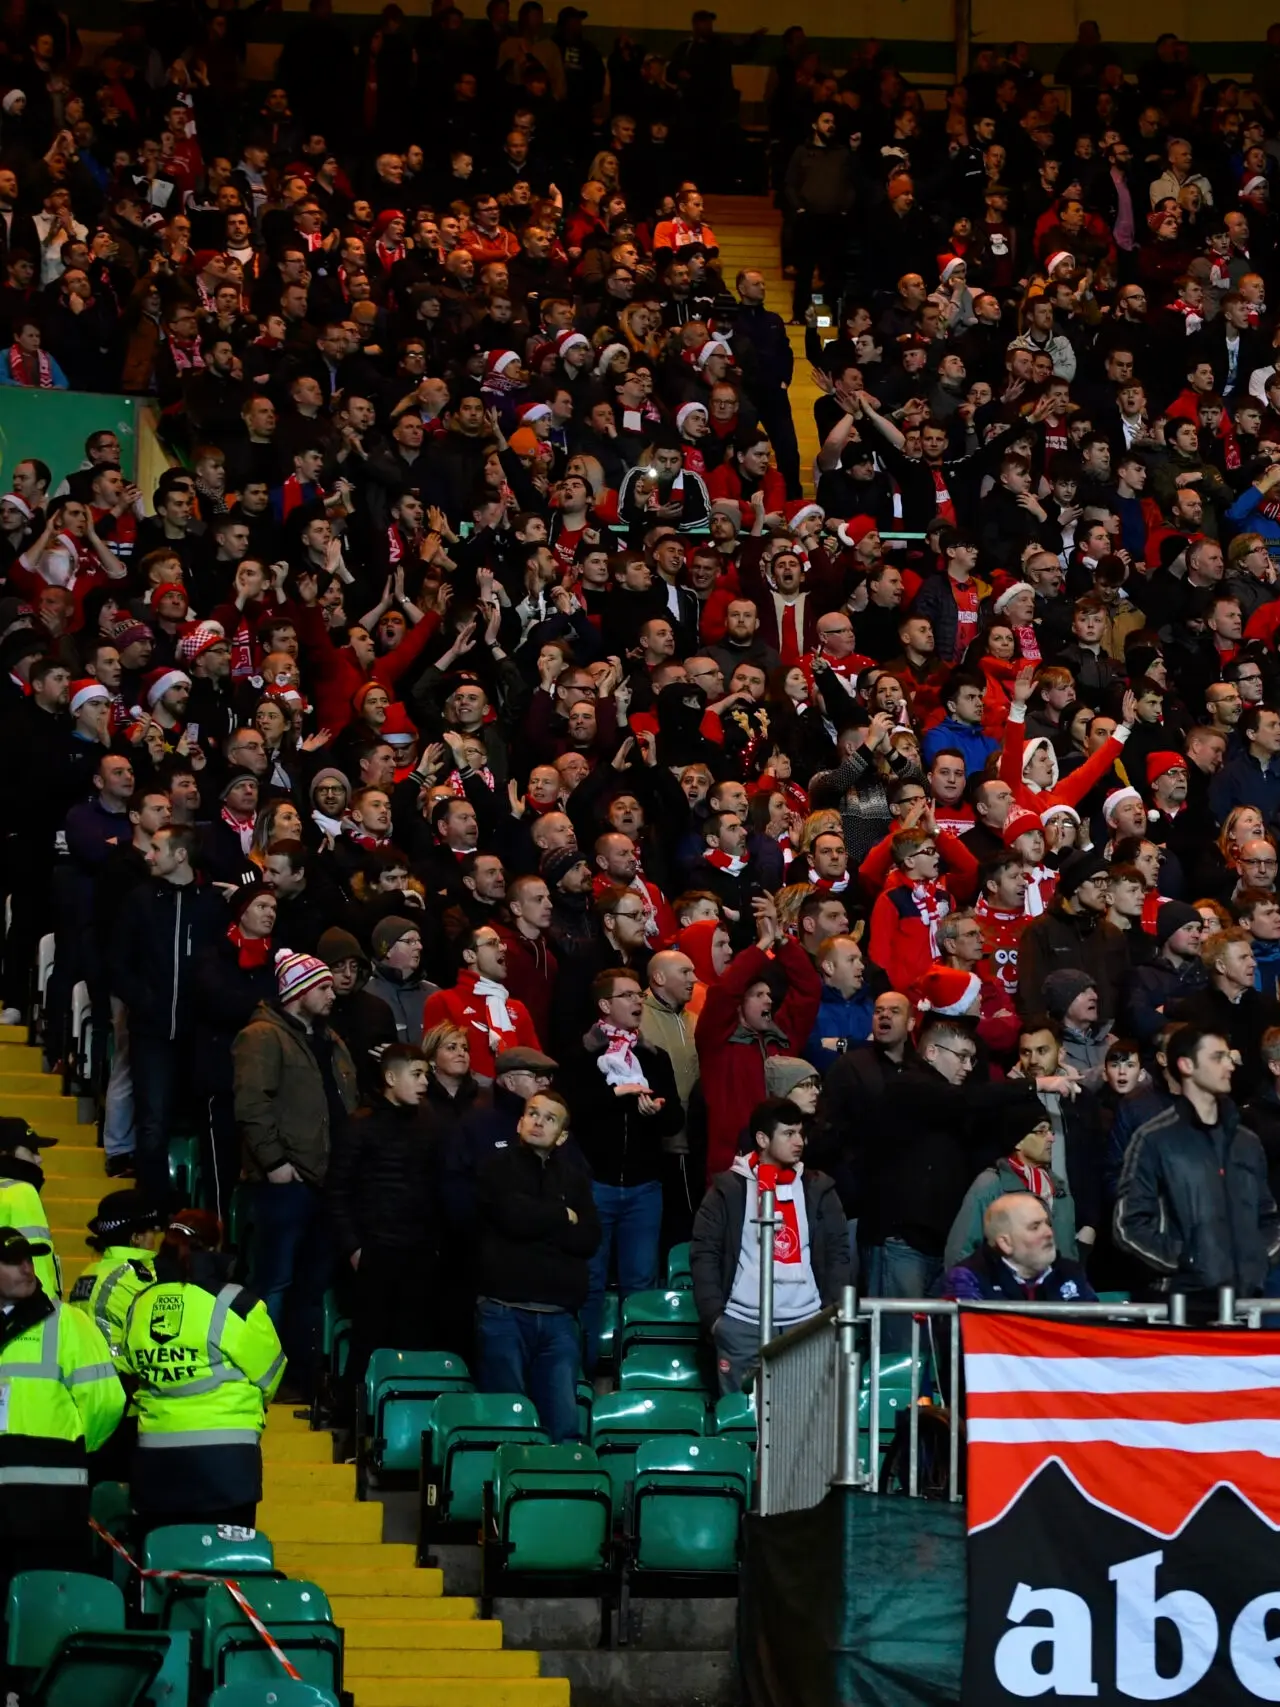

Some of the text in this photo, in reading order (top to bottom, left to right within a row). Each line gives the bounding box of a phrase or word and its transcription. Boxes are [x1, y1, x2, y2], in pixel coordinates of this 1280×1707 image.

[157, 1296, 181, 1304] ROCK
[153, 1303, 183, 1311] STEADY
[134, 1347, 199, 1366] EVENT
[140, 1366, 198, 1383] STAFF
